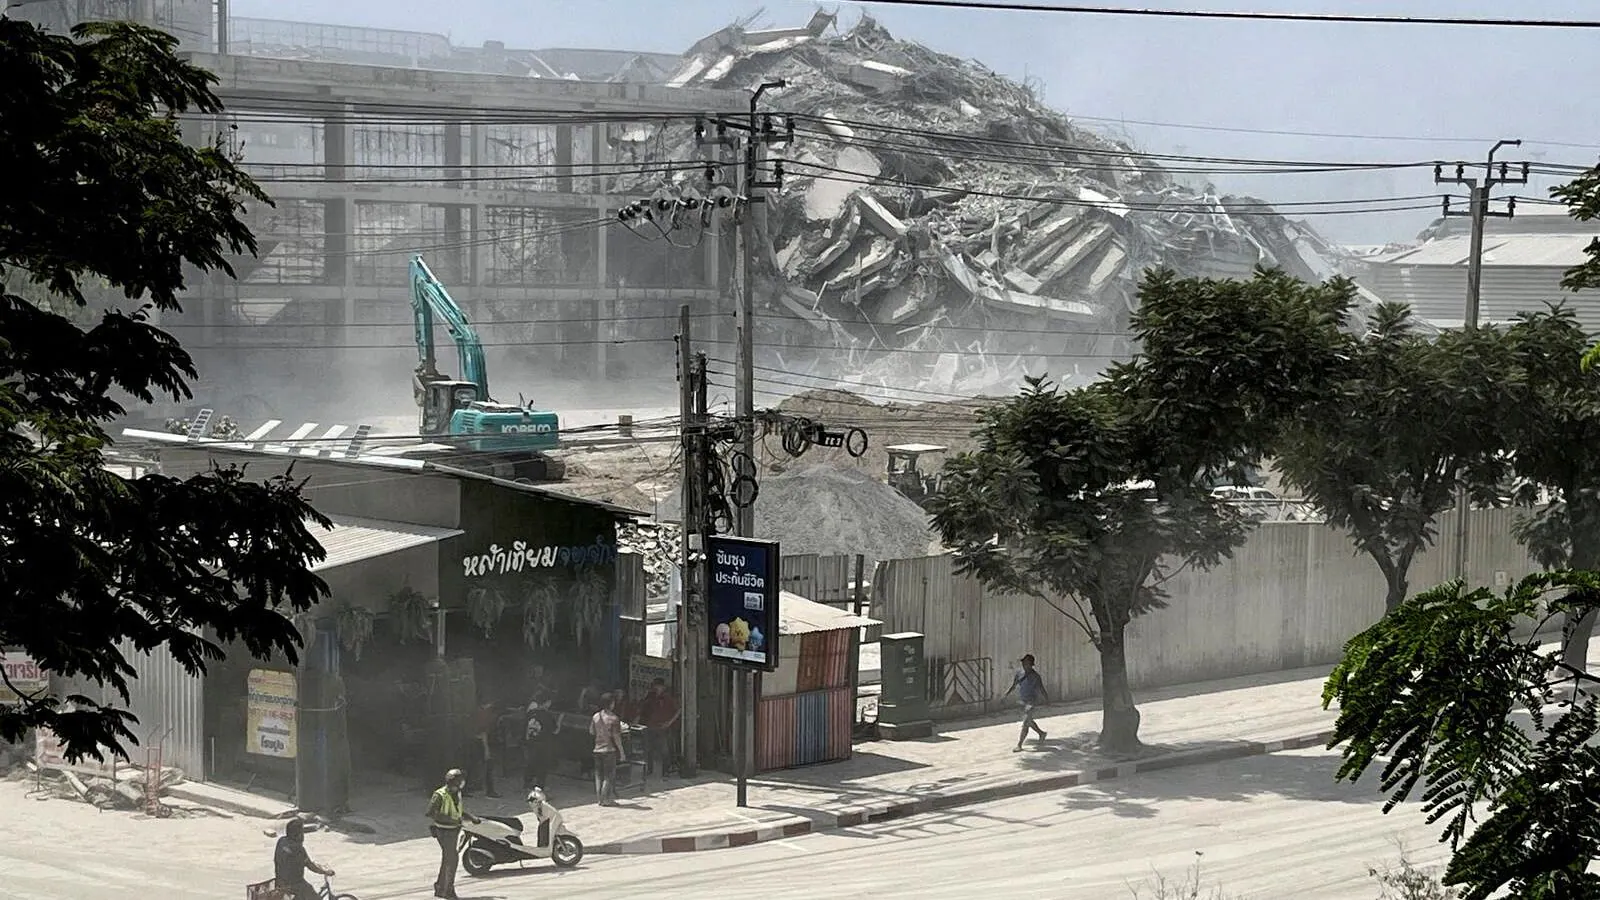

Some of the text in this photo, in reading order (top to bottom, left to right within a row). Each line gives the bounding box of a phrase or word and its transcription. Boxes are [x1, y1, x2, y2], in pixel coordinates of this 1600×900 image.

[715, 571, 765, 588] ประกันชีวิต
